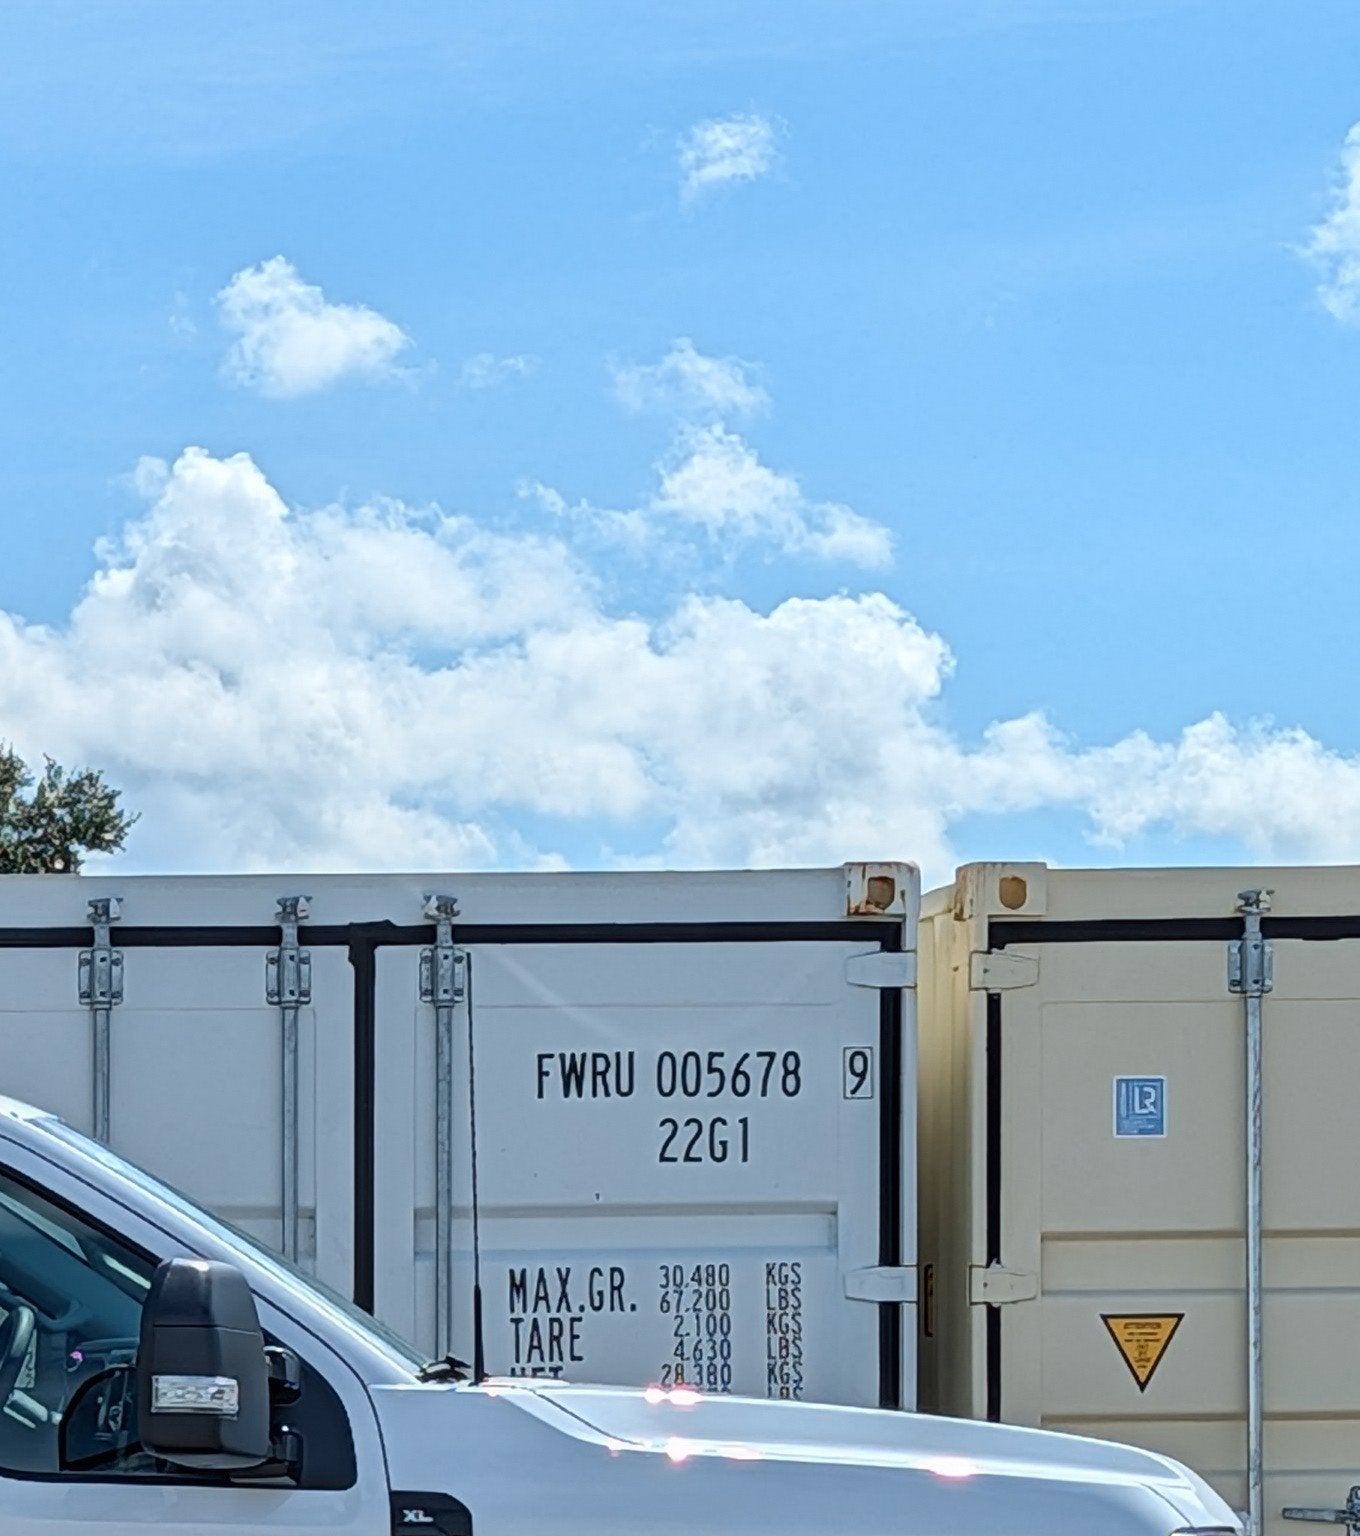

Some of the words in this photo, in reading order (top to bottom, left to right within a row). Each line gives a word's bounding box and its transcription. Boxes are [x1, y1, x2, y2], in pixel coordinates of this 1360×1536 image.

[536, 1050, 635, 1099] FWRU
[656, 1050, 802, 1098] 005678
[848, 1049, 869, 1096] 9
[658, 1116, 750, 1163] 22G1
[765, 1261, 803, 1288] KGS
[765, 1287, 803, 1312] LBS
[766, 1312, 803, 1337] KGS
[509, 1316, 585, 1364] TARE
[766, 1336, 804, 1361] LBS
[766, 1361, 804, 1386] KGS
[402, 1509, 434, 1523] XL
